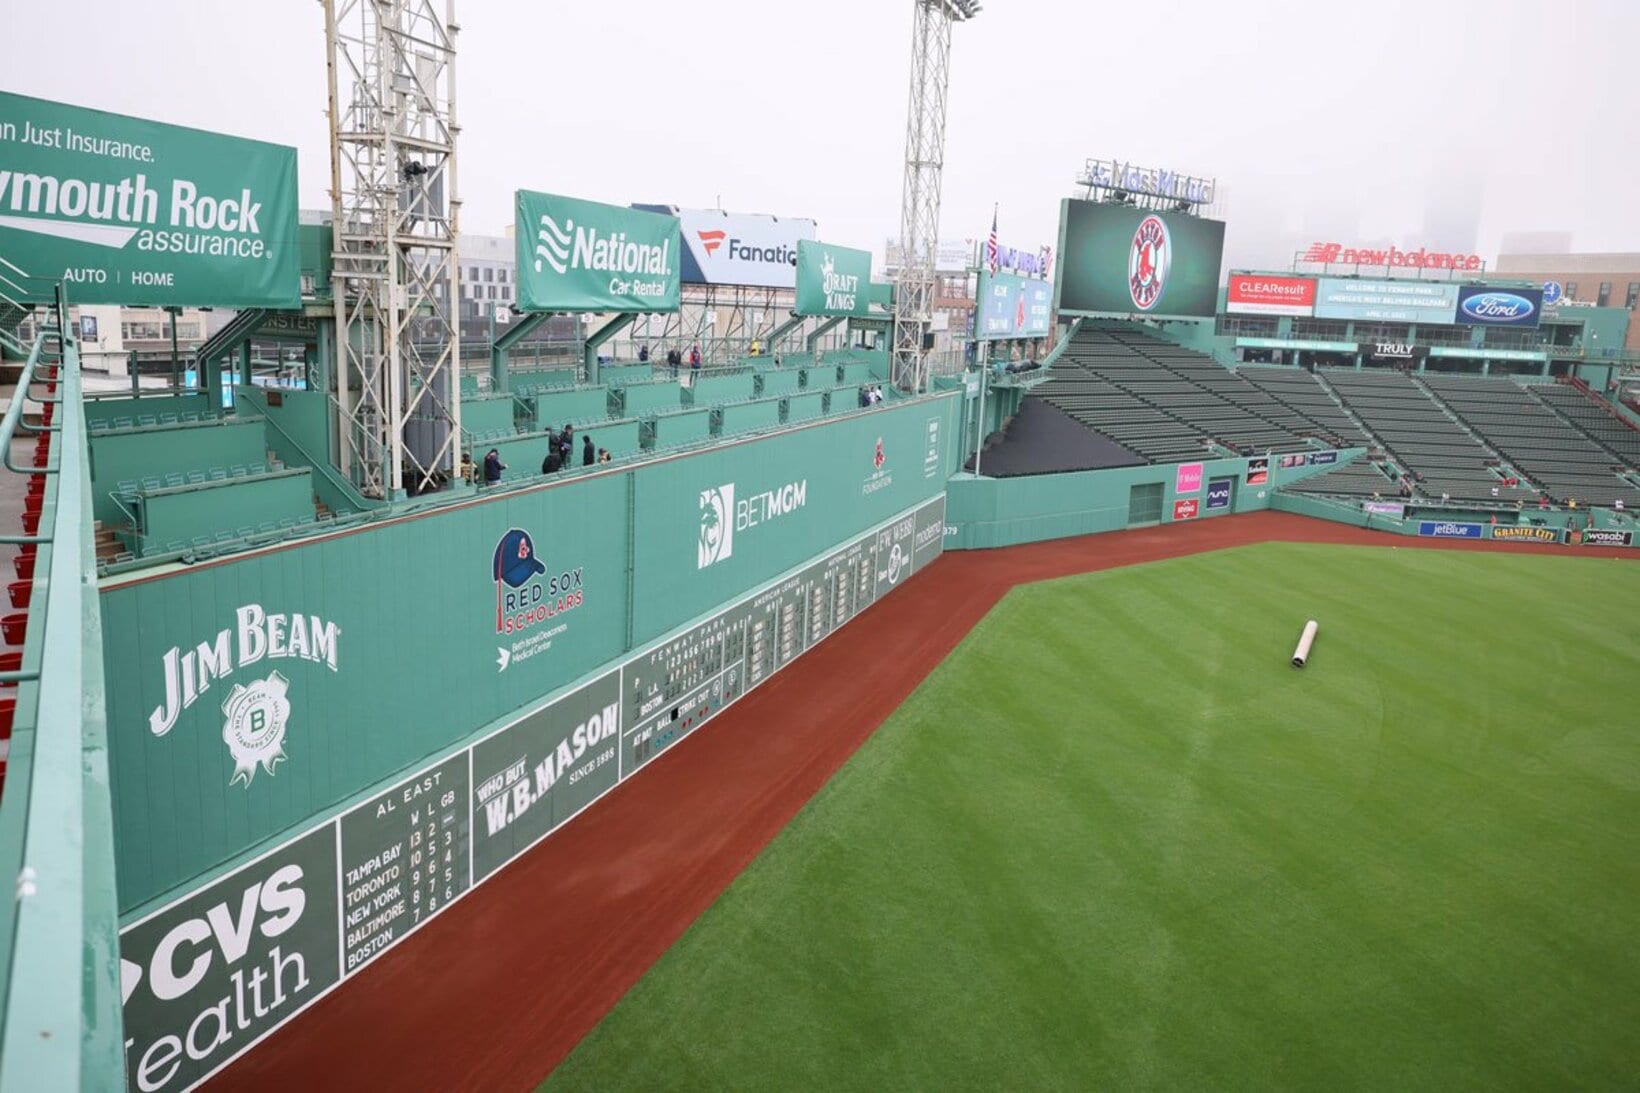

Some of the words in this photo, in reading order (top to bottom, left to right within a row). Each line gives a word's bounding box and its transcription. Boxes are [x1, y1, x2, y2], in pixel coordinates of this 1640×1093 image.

[21, 121, 62, 149] Just
[66, 128, 155, 163] Insurance.
[170, 178, 262, 234] Rock
[63, 267, 107, 283] AUTO
[131, 271, 174, 286] HOME
[1343, 248, 1387, 264] new
[1389, 246, 1481, 270] balance
[608, 278, 630, 295] Car
[633, 279, 665, 297] Rental
[823, 272, 858, 294] DRAFT
[825, 291, 856, 310] KINGS
[1239, 282, 1305, 295] CLEAResult
[1475, 295, 1520, 317] Ford
[1375, 342, 1414, 355] TRULY
[737, 480, 807, 531] BETMGM
[1433, 522, 1468, 536] jetBlue
[1494, 528, 1533, 537] GRANITE
[1588, 531, 1625, 541] wasabi
[506, 584, 542, 613] RED
[549, 566, 584, 596] SOX
[505, 591, 584, 635] SCHOLARS
[236, 603, 339, 672] BEAM
[651, 633, 695, 666] FENWAY
[700, 618, 726, 637] PARK
[149, 628, 233, 737] JIM
[250, 708, 265, 733] B
[633, 734, 642, 748] AT
[656, 713, 672, 732] BALL
[677, 697, 697, 719] STRIKE
[640, 694, 664, 717] BOSTON
[477, 774, 504, 803] WHO
[505, 760, 527, 787] BUT
[485, 702, 619, 838] W.B.MASON
[569, 759, 596, 786] SINCE
[376, 799, 397, 819] AL
[404, 772, 442, 804] EAST
[411, 810, 420, 827] W
[428, 803, 436, 817] L
[440, 790, 455, 808] GB
[346, 856, 382, 887] TAMPA
[382, 842, 403, 866] BAY
[410, 831, 422, 849] 13
[428, 823, 436, 838] 2
[347, 864, 400, 908] TORONTO
[410, 851, 422, 869] 10
[428, 841, 436, 856] 5
[445, 831, 452, 846] 3
[347, 903, 371, 929] NEW
[372, 883, 402, 912] YORK
[412, 871, 421, 886] 9
[428, 860, 436, 875] 6
[445, 849, 452, 864] 4
[347, 899, 406, 950] BALTIMORE
[413, 890, 421, 904] 8
[429, 878, 436, 894] 7
[445, 867, 452, 883] 5
[150, 864, 306, 1000] CVS
[348, 927, 394, 969] BOSTON
[413, 908, 421, 924] 7
[429, 897, 437, 912] 8
[445, 886, 452, 901] 6
[125, 945, 310, 1093] ealth
